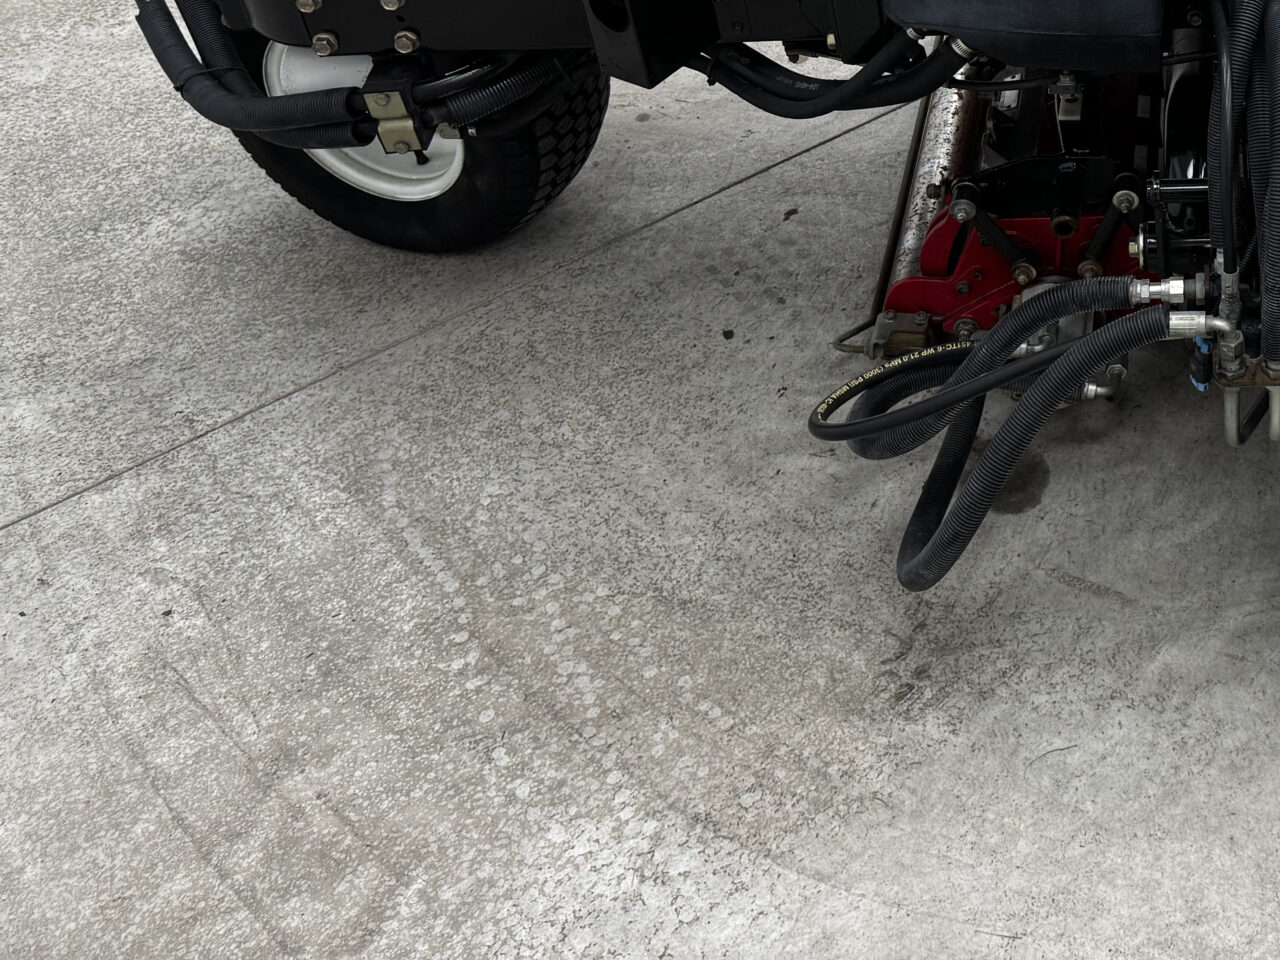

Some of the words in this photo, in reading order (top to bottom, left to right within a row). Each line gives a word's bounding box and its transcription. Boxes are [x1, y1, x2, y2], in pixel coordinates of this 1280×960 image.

[902, 352, 920, 362] 21.0
[921, 347, 935, 357] WP
[884, 357, 902, 368] MPa
